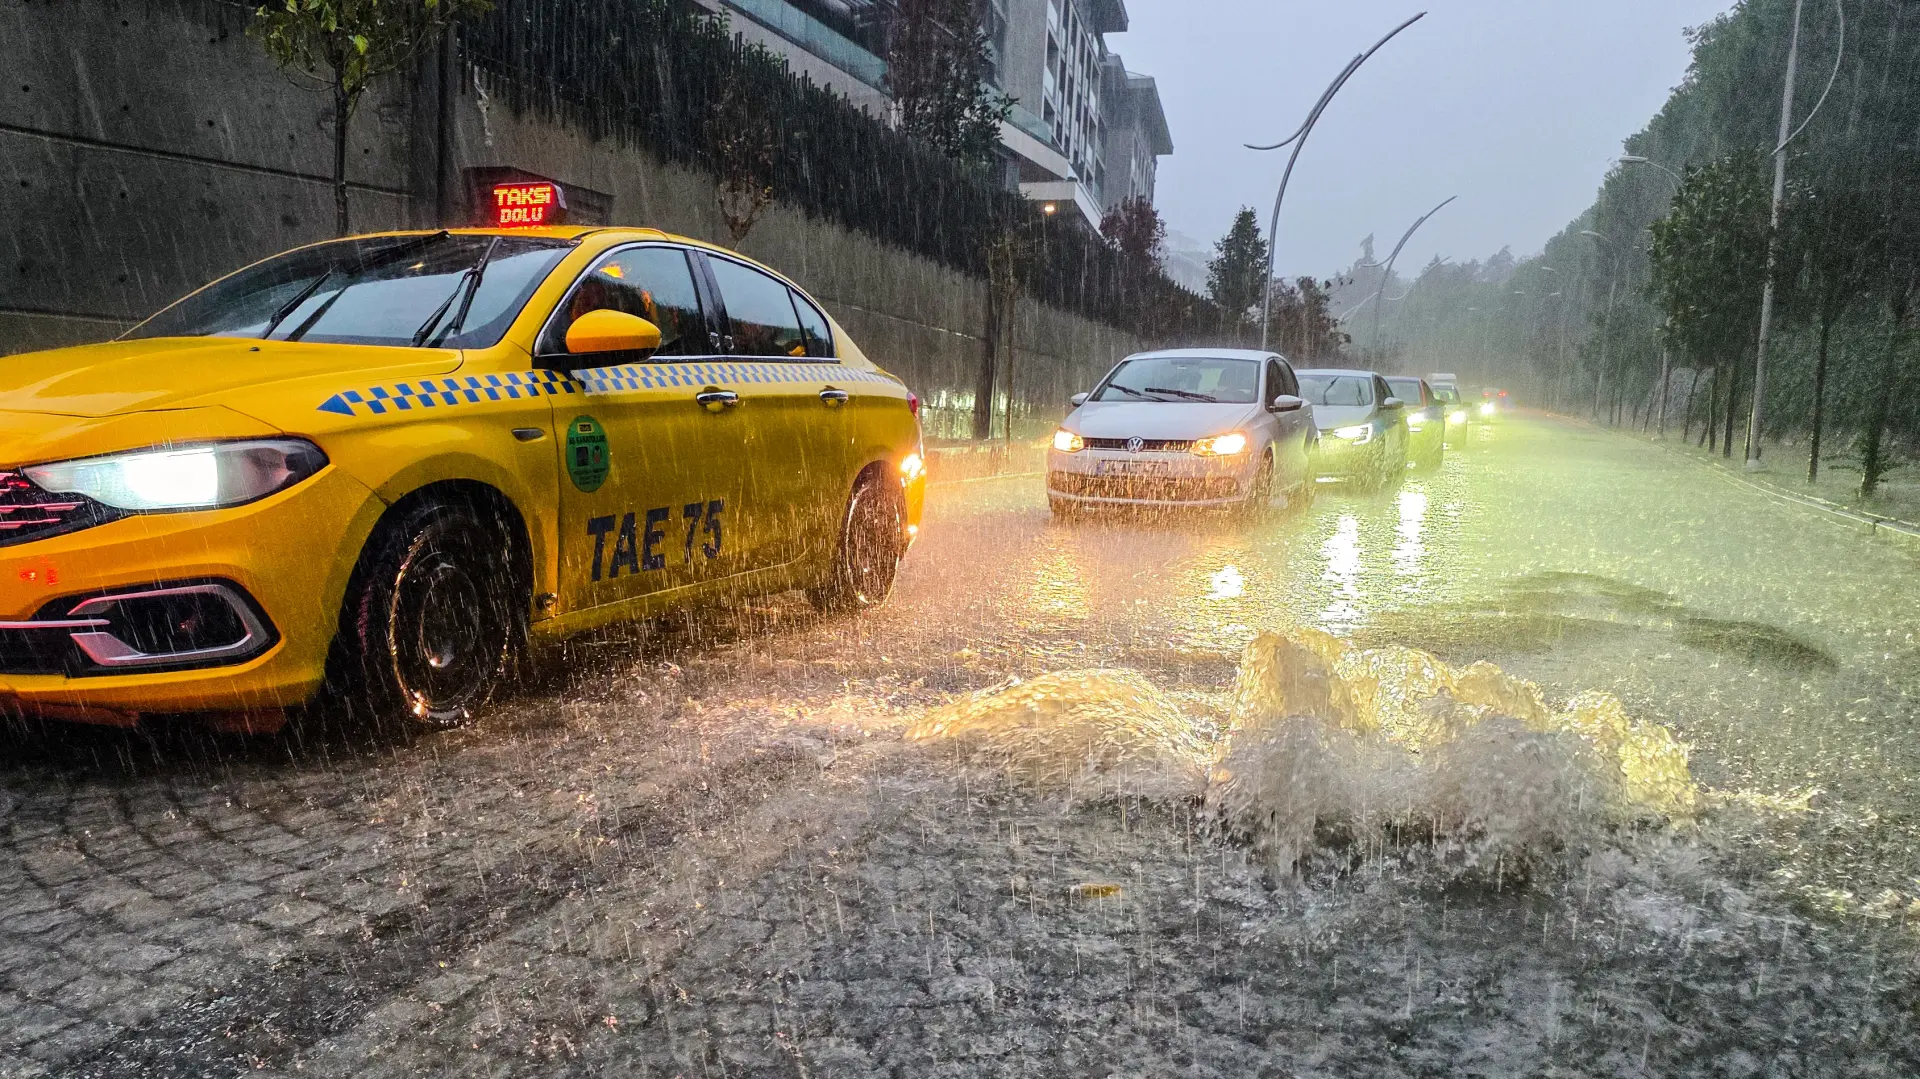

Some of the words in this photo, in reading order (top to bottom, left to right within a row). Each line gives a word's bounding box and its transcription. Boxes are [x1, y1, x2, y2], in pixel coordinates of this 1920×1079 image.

[500, 207, 543, 223] DOLU
[587, 506, 670, 582] TAE
[683, 499, 724, 564] 75
